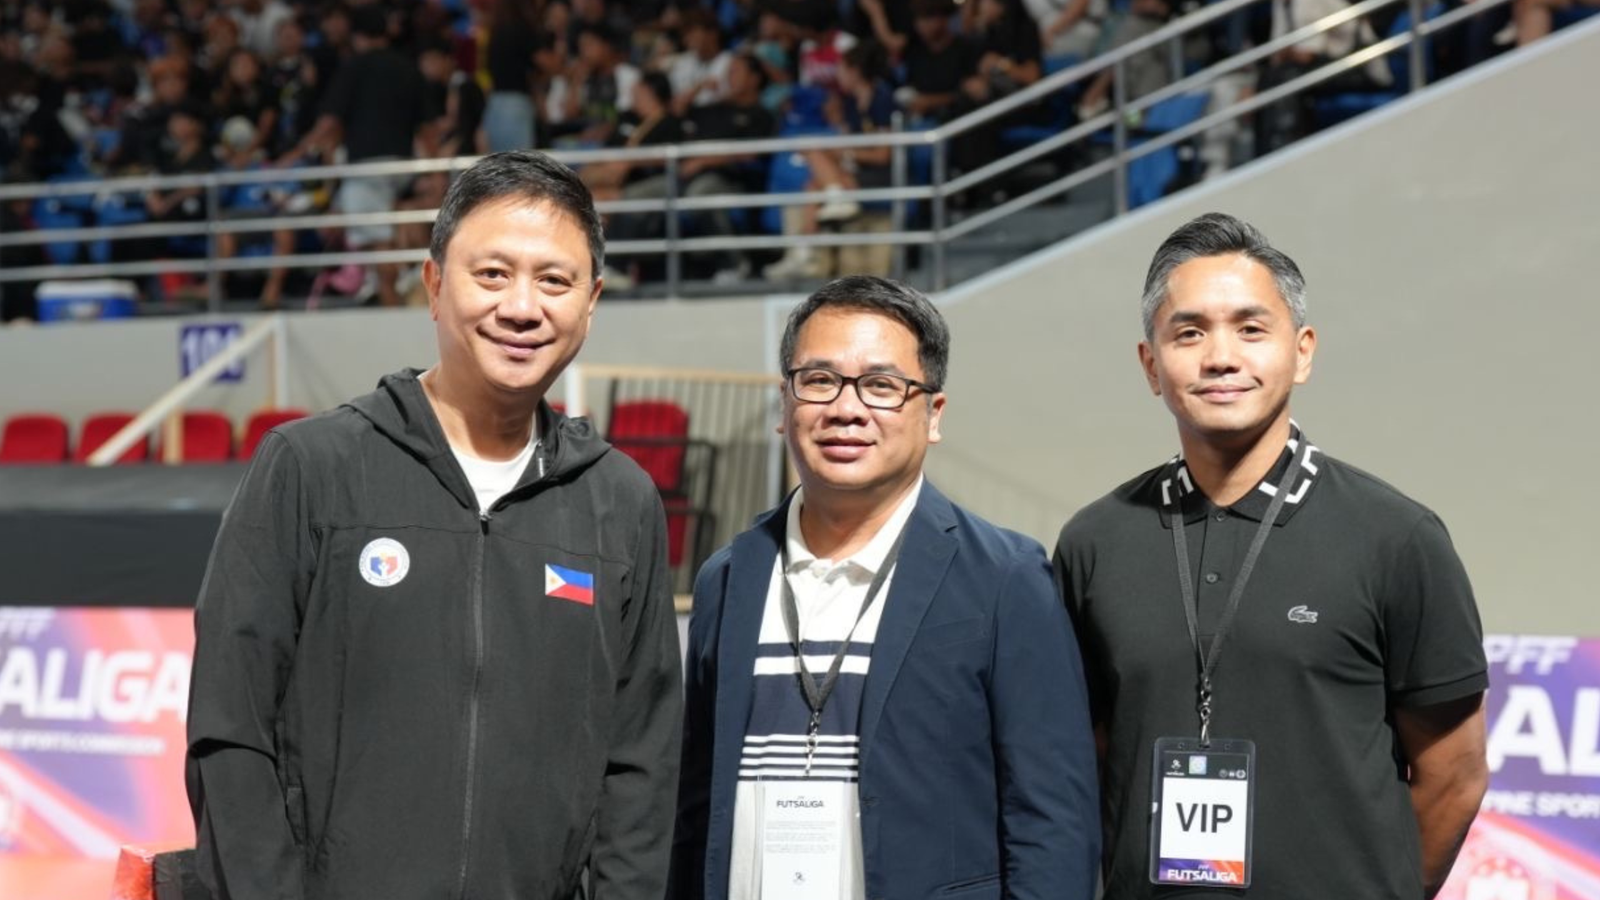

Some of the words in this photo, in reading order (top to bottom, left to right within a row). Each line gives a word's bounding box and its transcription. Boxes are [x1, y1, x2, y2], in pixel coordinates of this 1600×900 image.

[0, 647, 190, 722] ALIGA
[776, 800, 824, 808] FUTSALIGA
[1175, 802, 1233, 833] VIP
[1168, 869, 1237, 882] FUTSALIGA
